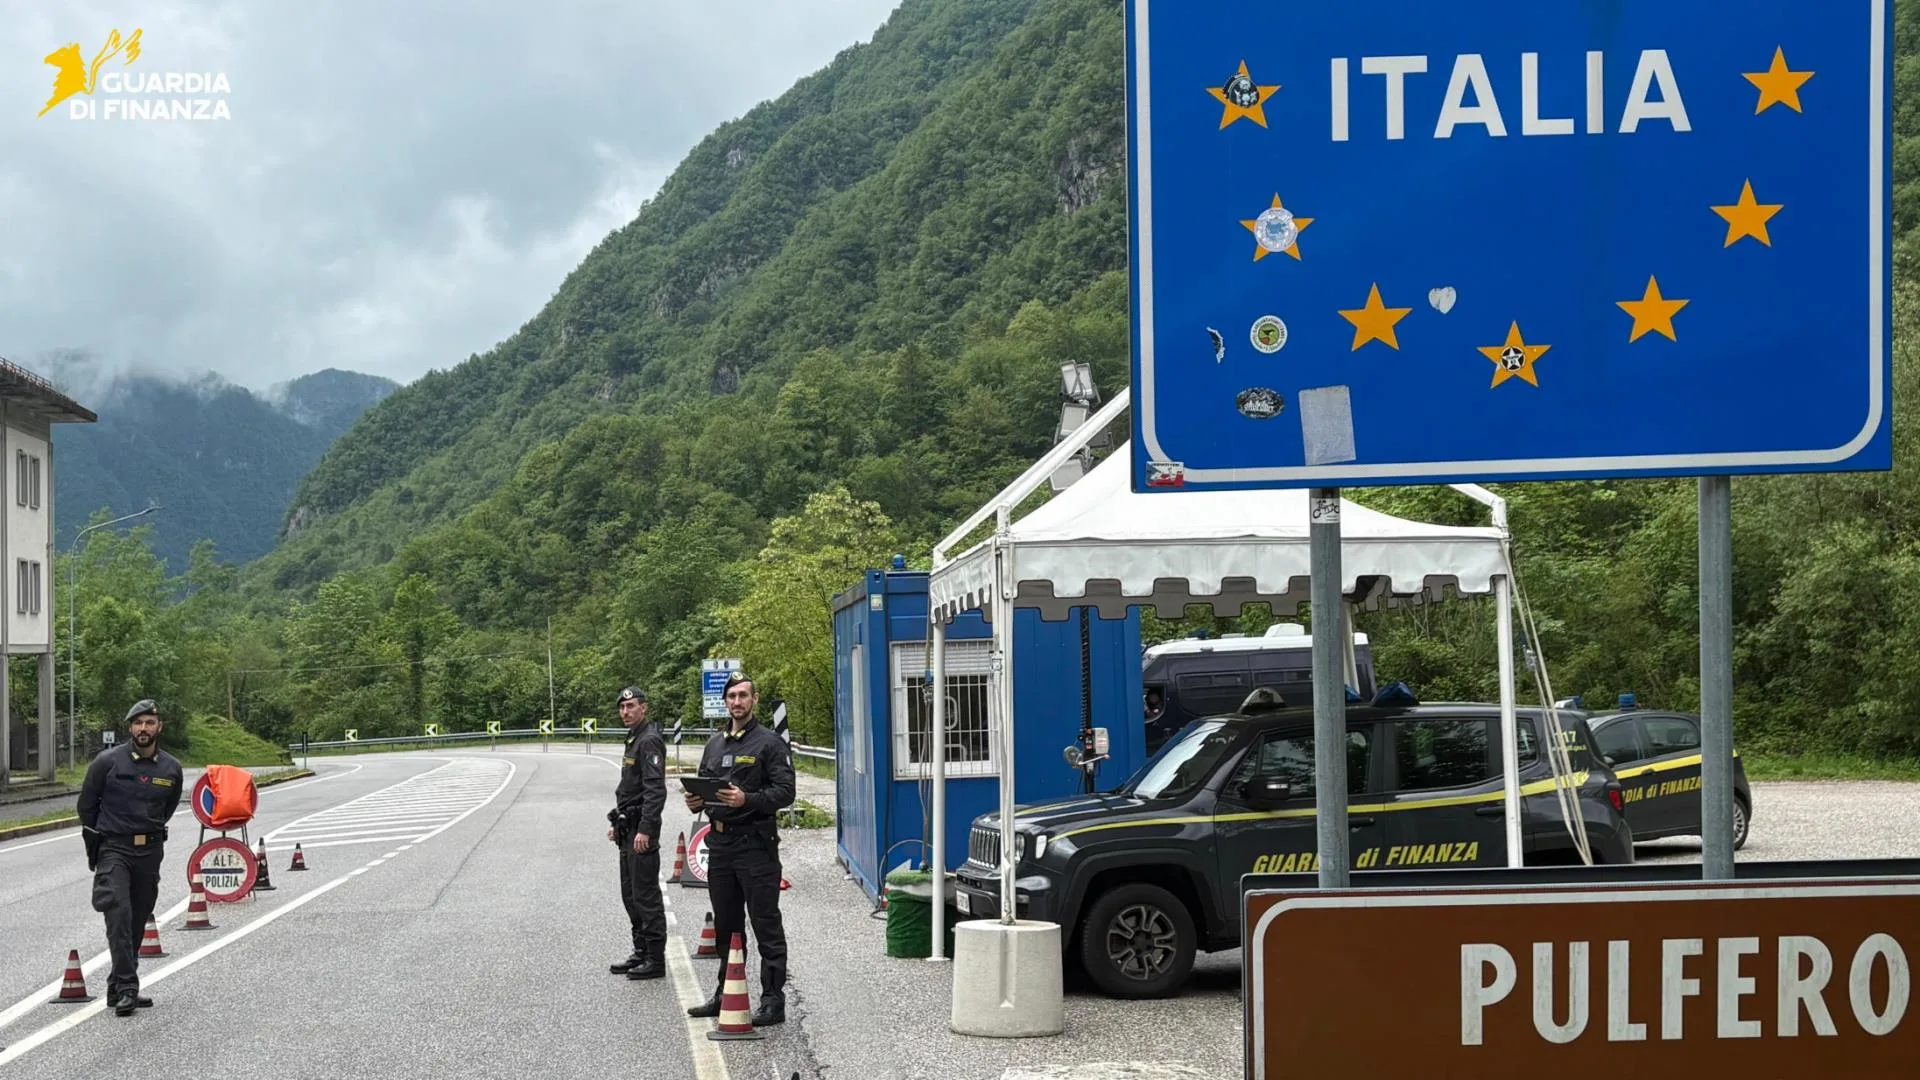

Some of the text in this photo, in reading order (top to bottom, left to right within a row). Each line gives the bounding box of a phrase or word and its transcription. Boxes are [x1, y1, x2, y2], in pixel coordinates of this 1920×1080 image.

[1331, 49, 1692, 141] ITALIA
[1646, 784, 1658, 798] di
[1660, 776, 1703, 796] FINANZA
[213, 854, 233, 867] ALT
[1252, 841, 1479, 873] GUAR di FINANZA
[205, 875, 240, 888] POLIZIA
[1461, 932, 1910, 1046] PULFERO
